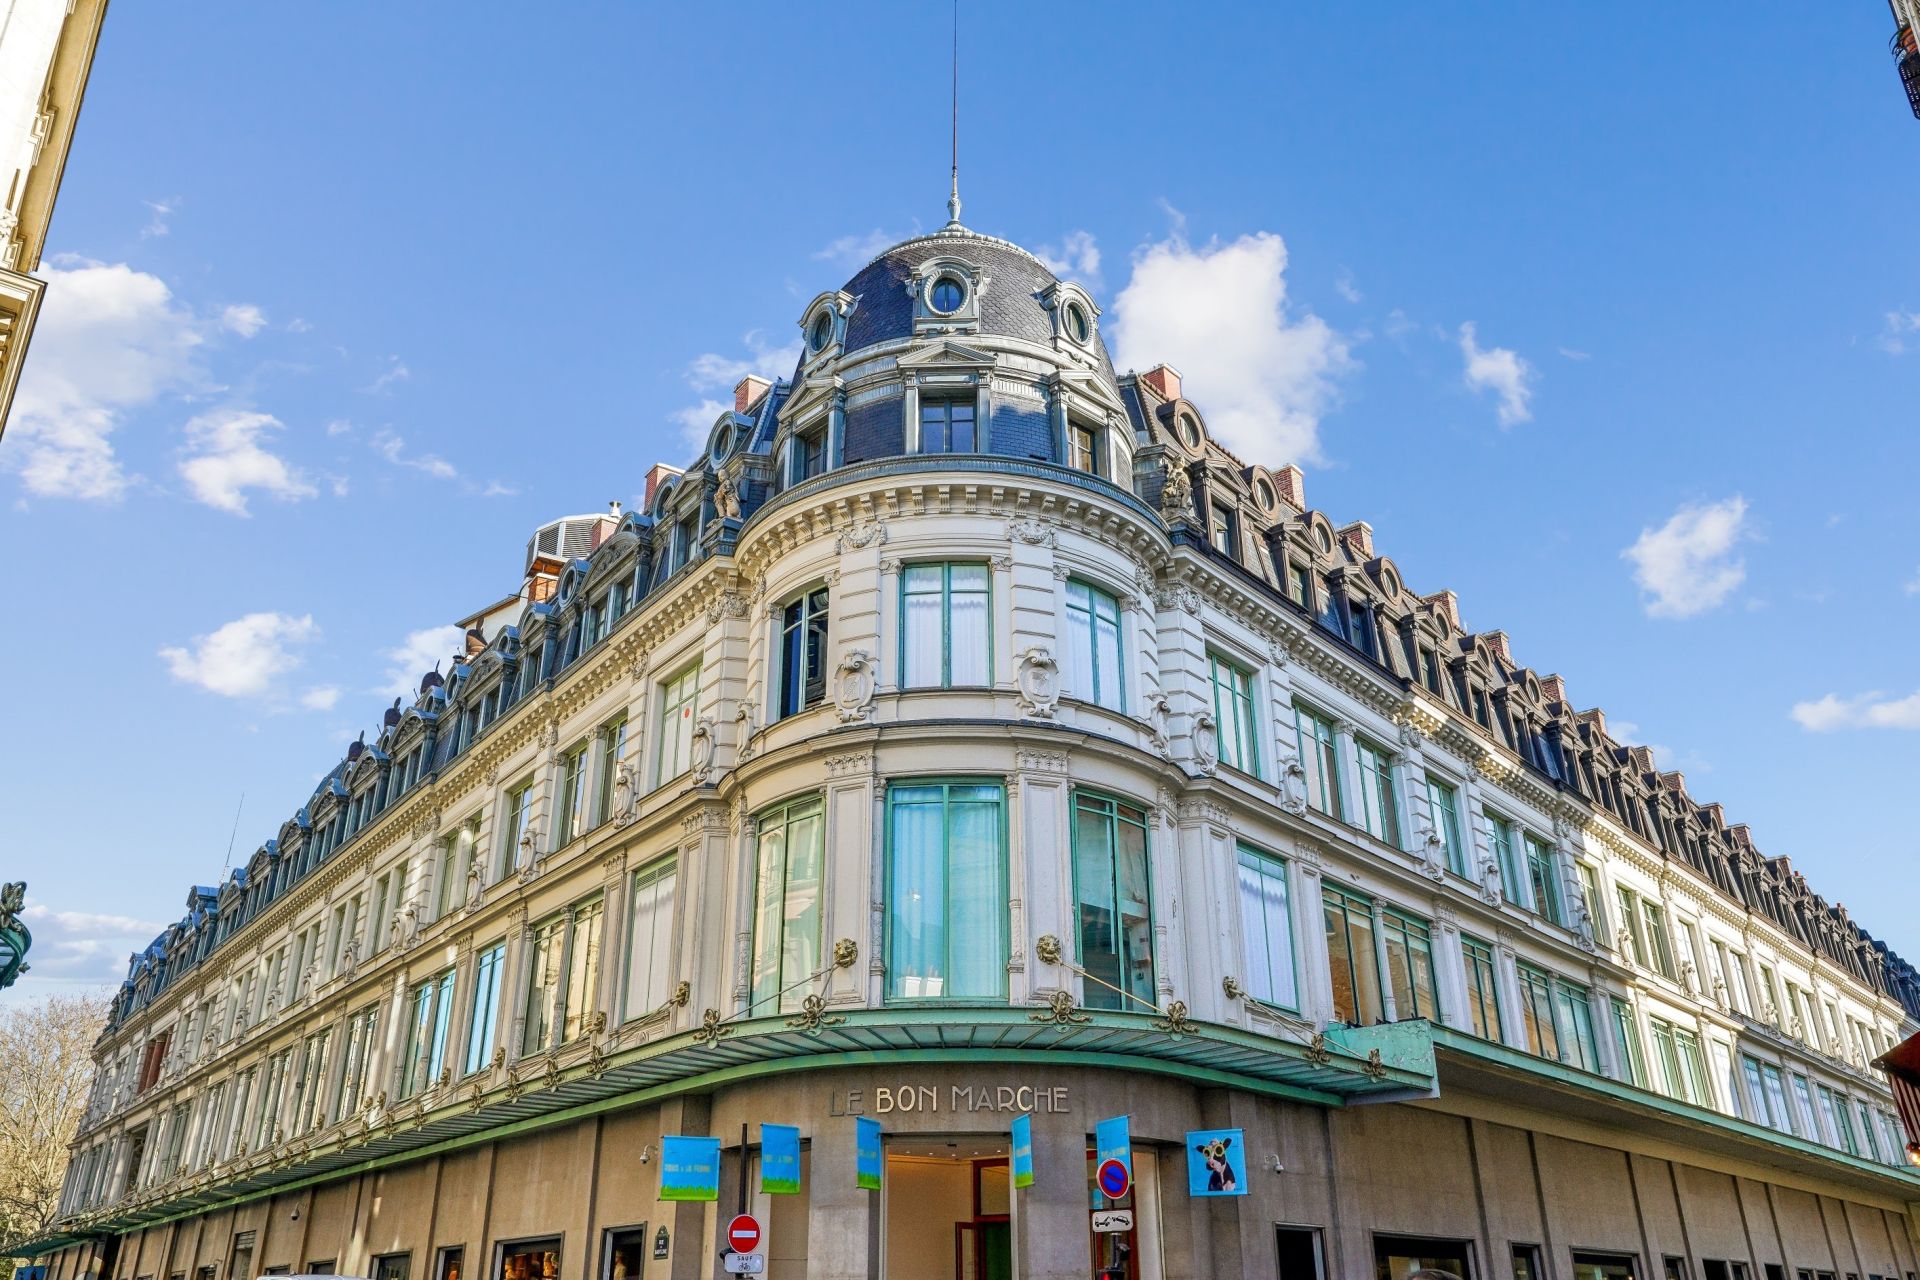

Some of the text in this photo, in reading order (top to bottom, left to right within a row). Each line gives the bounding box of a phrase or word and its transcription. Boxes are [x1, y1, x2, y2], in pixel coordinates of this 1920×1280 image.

[830, 1085, 1071, 1117] LE BON MARCHE
